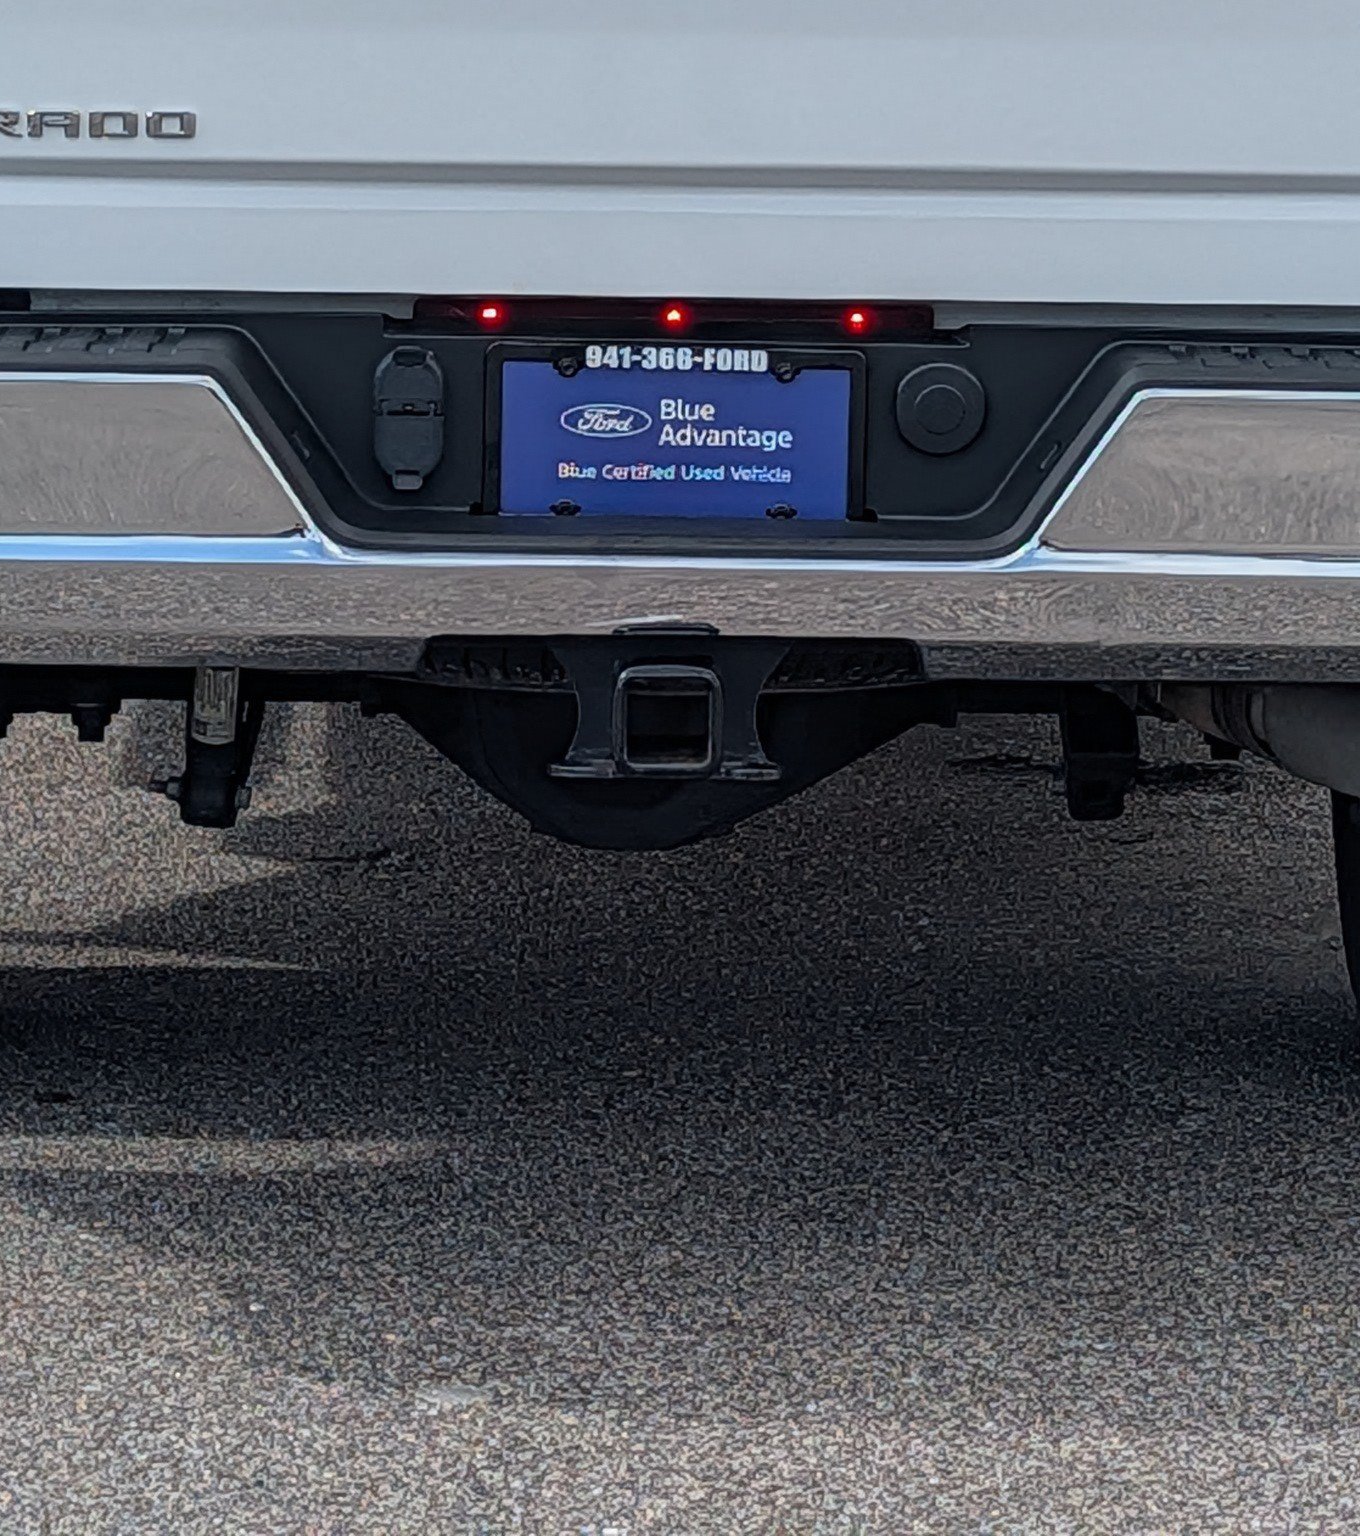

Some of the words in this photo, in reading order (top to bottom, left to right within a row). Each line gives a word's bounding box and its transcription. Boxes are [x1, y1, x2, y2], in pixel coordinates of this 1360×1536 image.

[577, 408, 634, 432] Ford
[660, 398, 716, 421] Blue
[658, 424, 794, 452] Advantage
[558, 462, 597, 479] Blue
[602, 463, 676, 481] Certified
[681, 465, 725, 481] Used
[730, 466, 792, 483] Vehicle
